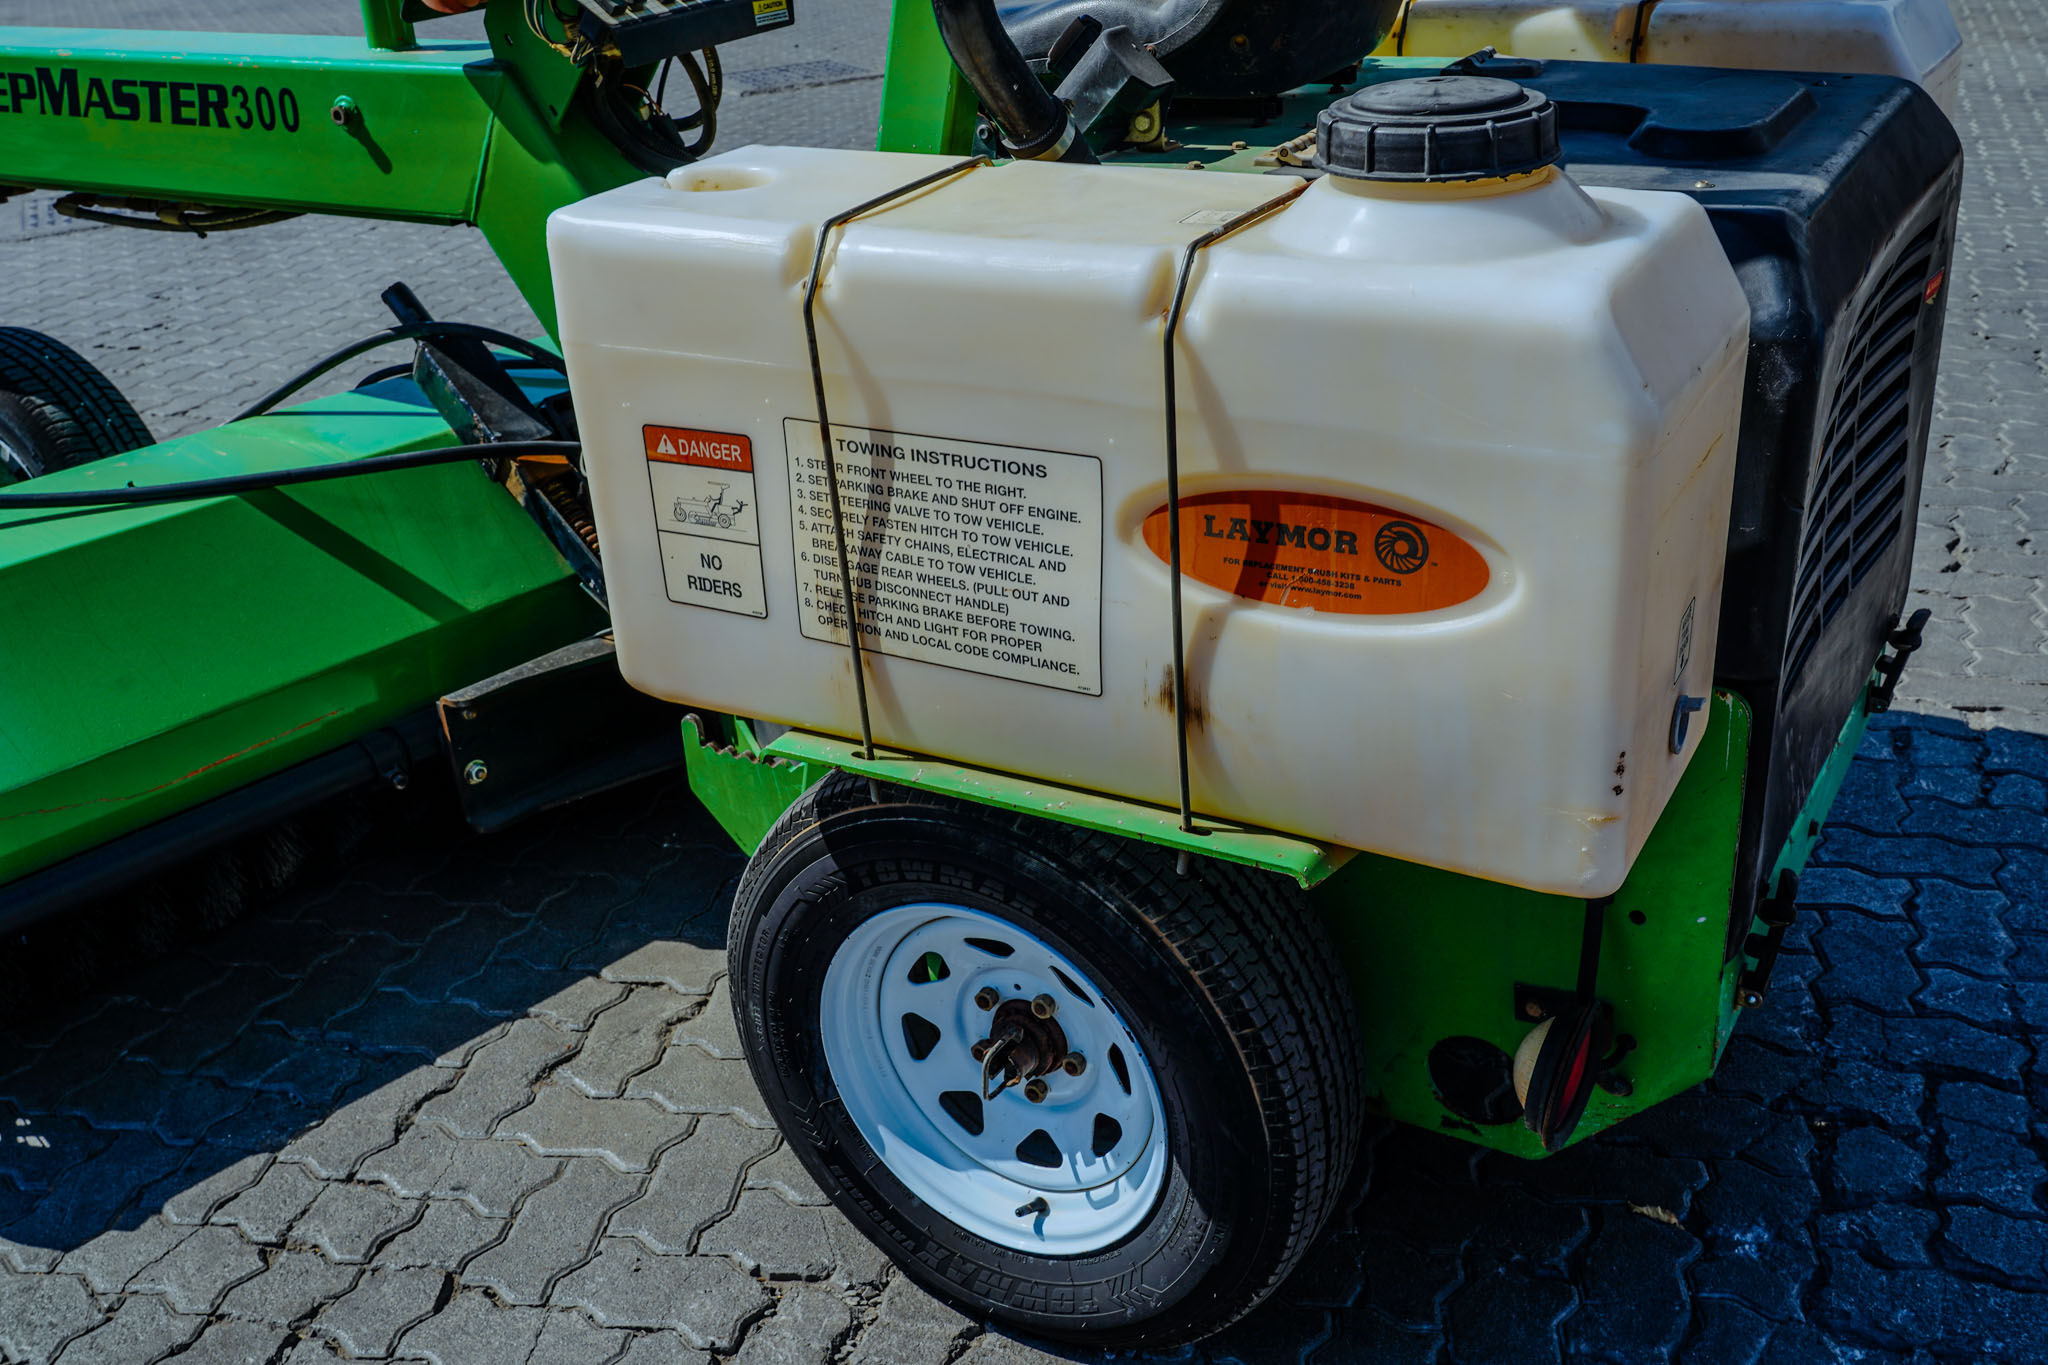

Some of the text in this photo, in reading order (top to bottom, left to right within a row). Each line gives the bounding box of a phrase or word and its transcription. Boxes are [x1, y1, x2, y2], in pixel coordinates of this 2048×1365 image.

[678, 439, 742, 462] DANGER
[836, 438, 1047, 478] TOWING INSTRUCTIONS
[795, 457, 1027, 499] 1. STER FRONT WHEEL TO THE RIGHT.
[796, 473, 805, 483] 2.
[808, 474, 830, 487] SET
[887, 486, 928, 502] BRAKE
[932, 493, 958, 506] AND
[961, 497, 996, 511] SHUT
[999, 502, 1024, 515] OFF
[1028, 506, 1081, 524] ENGINE.
[797, 489, 1044, 536] 3. SET TEERING VALVE TO TOW VEHICLE.
[798, 505, 1073, 557] 4. SECRELY FASTEN HITCH TO TOW VEHICLE.
[799, 520, 1066, 573] 5. ATTAH SAFETY CHAINS, ELECTRICAL AND
[1204, 514, 1359, 555] LAYMOR
[700, 553, 723, 570] NO
[801, 552, 1070, 607] 6. DISEGAGE REAR WHEELS. (PULL OUT AND
[812, 538, 1036, 585] BREKAWAY CABLE TO TOW VEHICLE.
[1223, 557, 1240, 565] FOR
[1307, 567, 1338, 578] BRUSH
[1340, 572, 1361, 582] KITS
[1373, 576, 1402, 587] PARTS
[1266, 571, 1289, 580] CALL
[687, 575, 742, 598] RIDERS
[875, 580, 951, 605] DISCONNECT
[955, 596, 1009, 616] HANDLE)
[1290, 585, 1362, 600] www.laymor.com
[803, 583, 1075, 642] 7. RELESE PARKING BRAKE BEFORE TOWING.
[804, 598, 1042, 652] 8. CHEC HITCH AND LIGHT FOR PROPER
[818, 615, 1080, 675] OPERTION AND LOCAL CODE COMPLIANCE.
